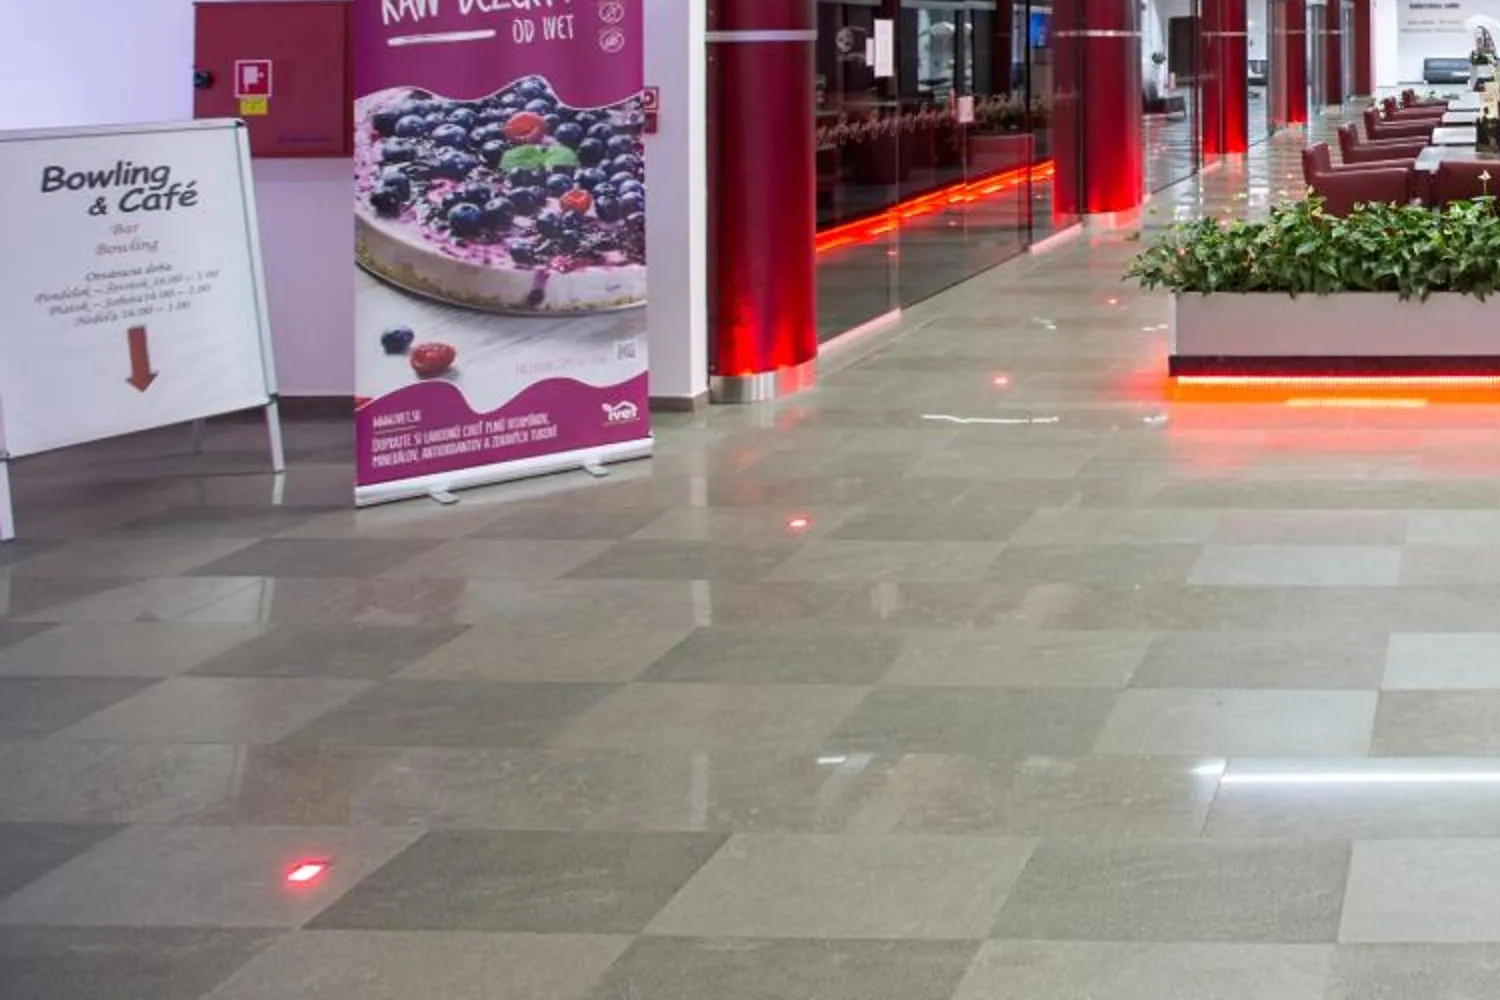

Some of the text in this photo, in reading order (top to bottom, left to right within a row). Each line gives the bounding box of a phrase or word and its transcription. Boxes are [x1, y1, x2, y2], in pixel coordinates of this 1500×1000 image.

[512, 17, 536, 43] OD
[41, 160, 171, 193] Bowling
[88, 180, 199, 217] & Café
